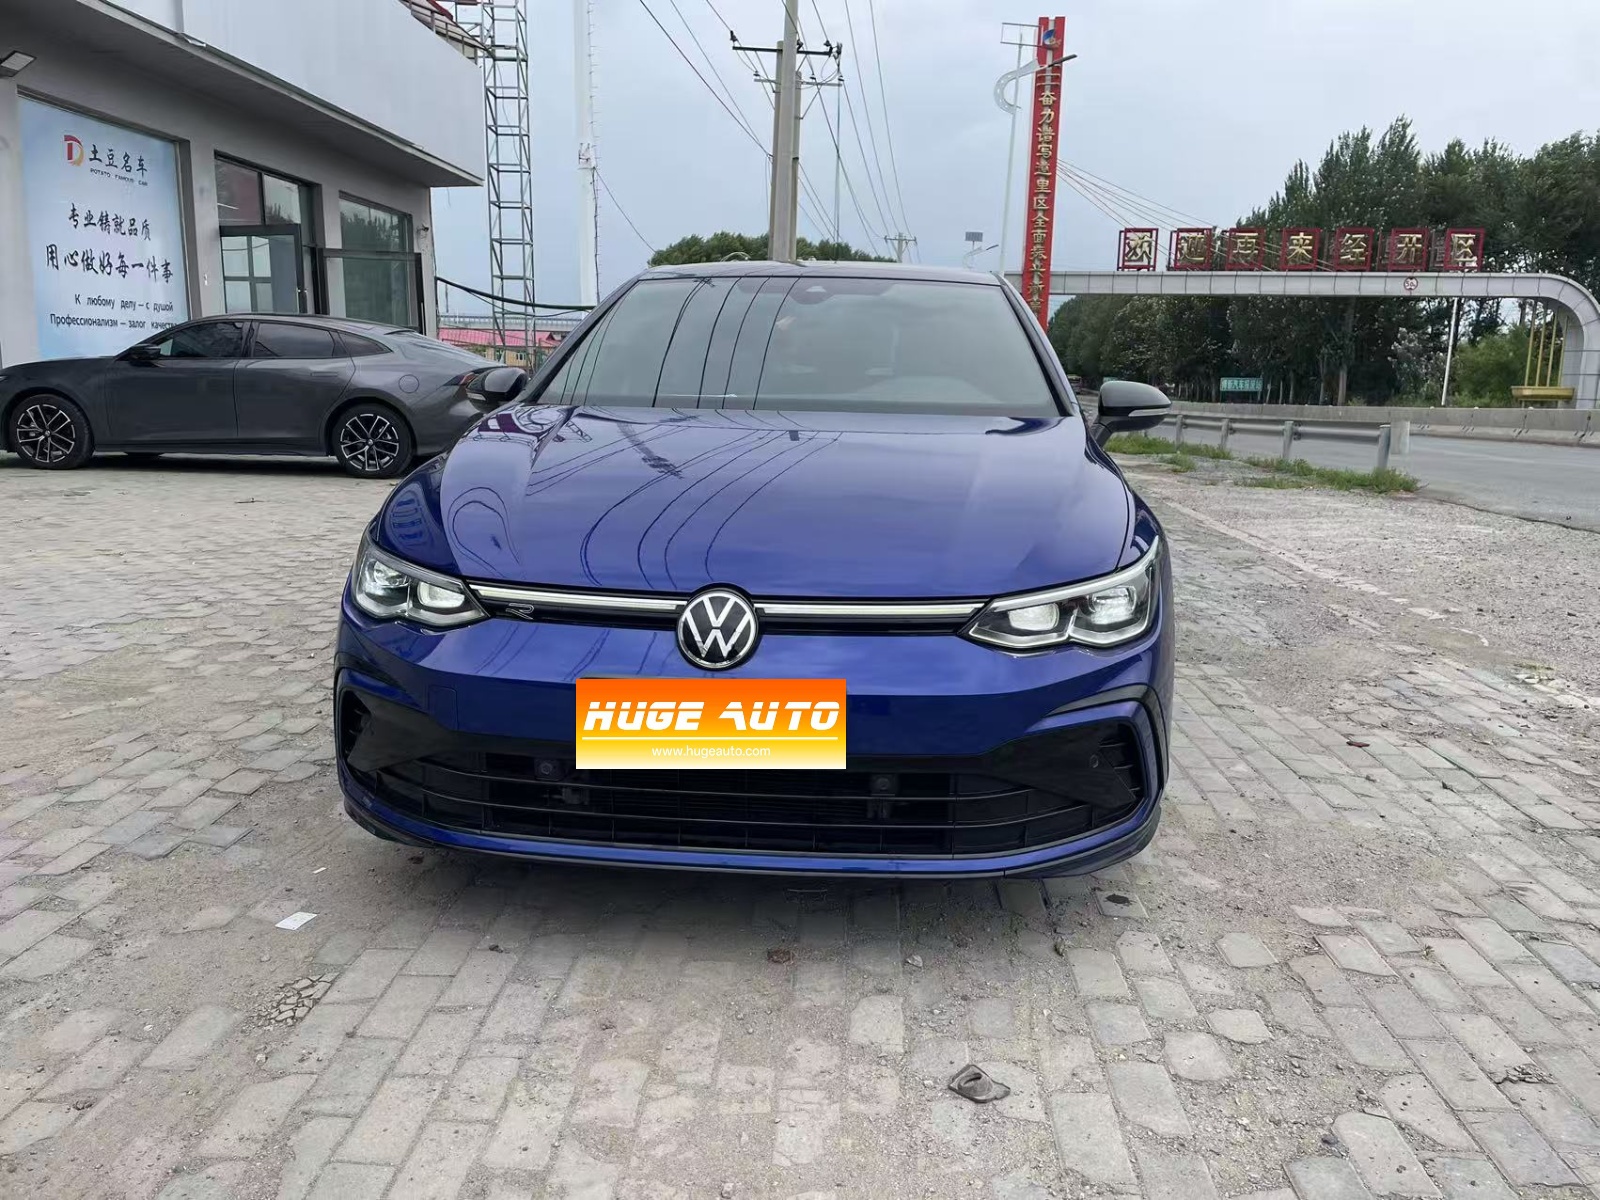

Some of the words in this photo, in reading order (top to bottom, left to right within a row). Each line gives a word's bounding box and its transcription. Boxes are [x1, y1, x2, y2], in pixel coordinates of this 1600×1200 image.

[89, 144, 147, 177] 土豆名车
[69, 203, 151, 240] 专业铸就品质
[46, 243, 173, 283] 用心做好每一件事
[1126, 231, 1478, 265] 欢迎再来经开区
[75, 294, 81, 305] К
[87, 295, 115, 309] любому
[120, 300, 137, 311] делу
[145, 302, 150, 310] с
[153, 301, 174, 312] душой
[50, 313, 118, 328] Профессионализм
[128, 319, 146, 329] залог
